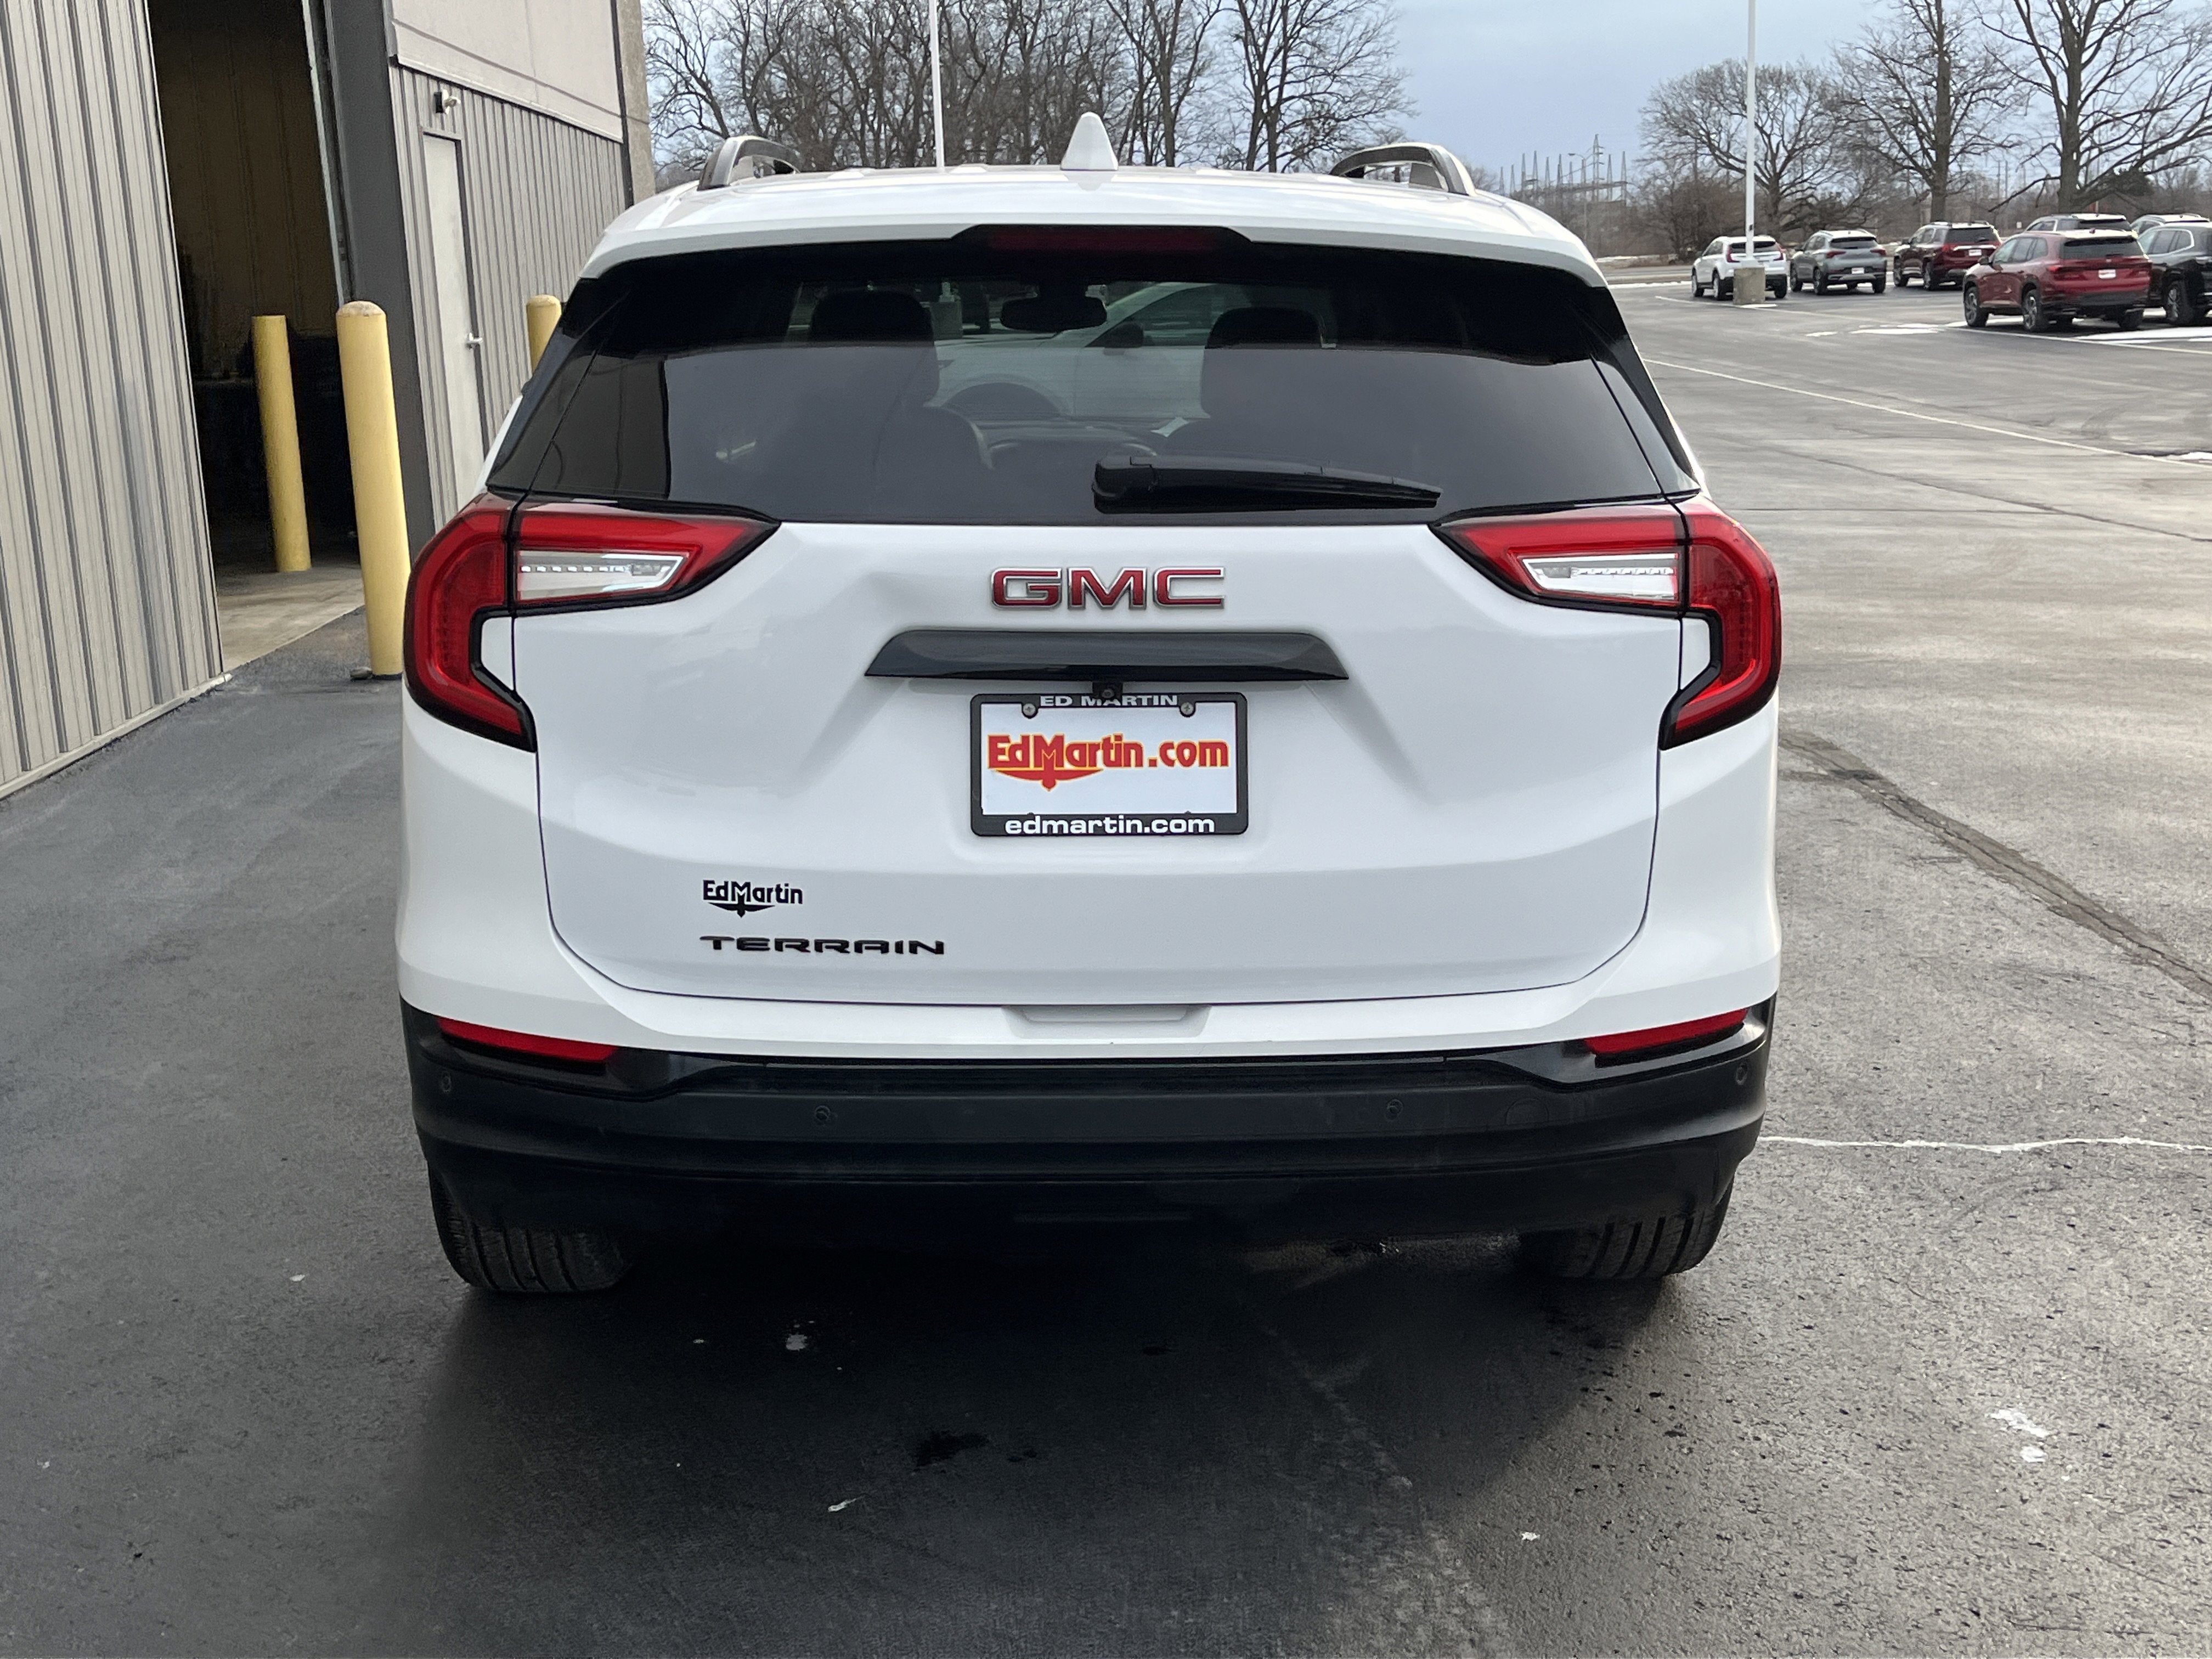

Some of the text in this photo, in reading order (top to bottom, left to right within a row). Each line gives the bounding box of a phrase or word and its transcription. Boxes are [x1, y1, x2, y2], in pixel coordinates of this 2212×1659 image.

[991, 567, 1225, 610] GMC
[1040, 695, 1178, 707] ED MARTIN
[1005, 815, 1215, 834] edmartin.com
[699, 935, 944, 955] TERRAIN
